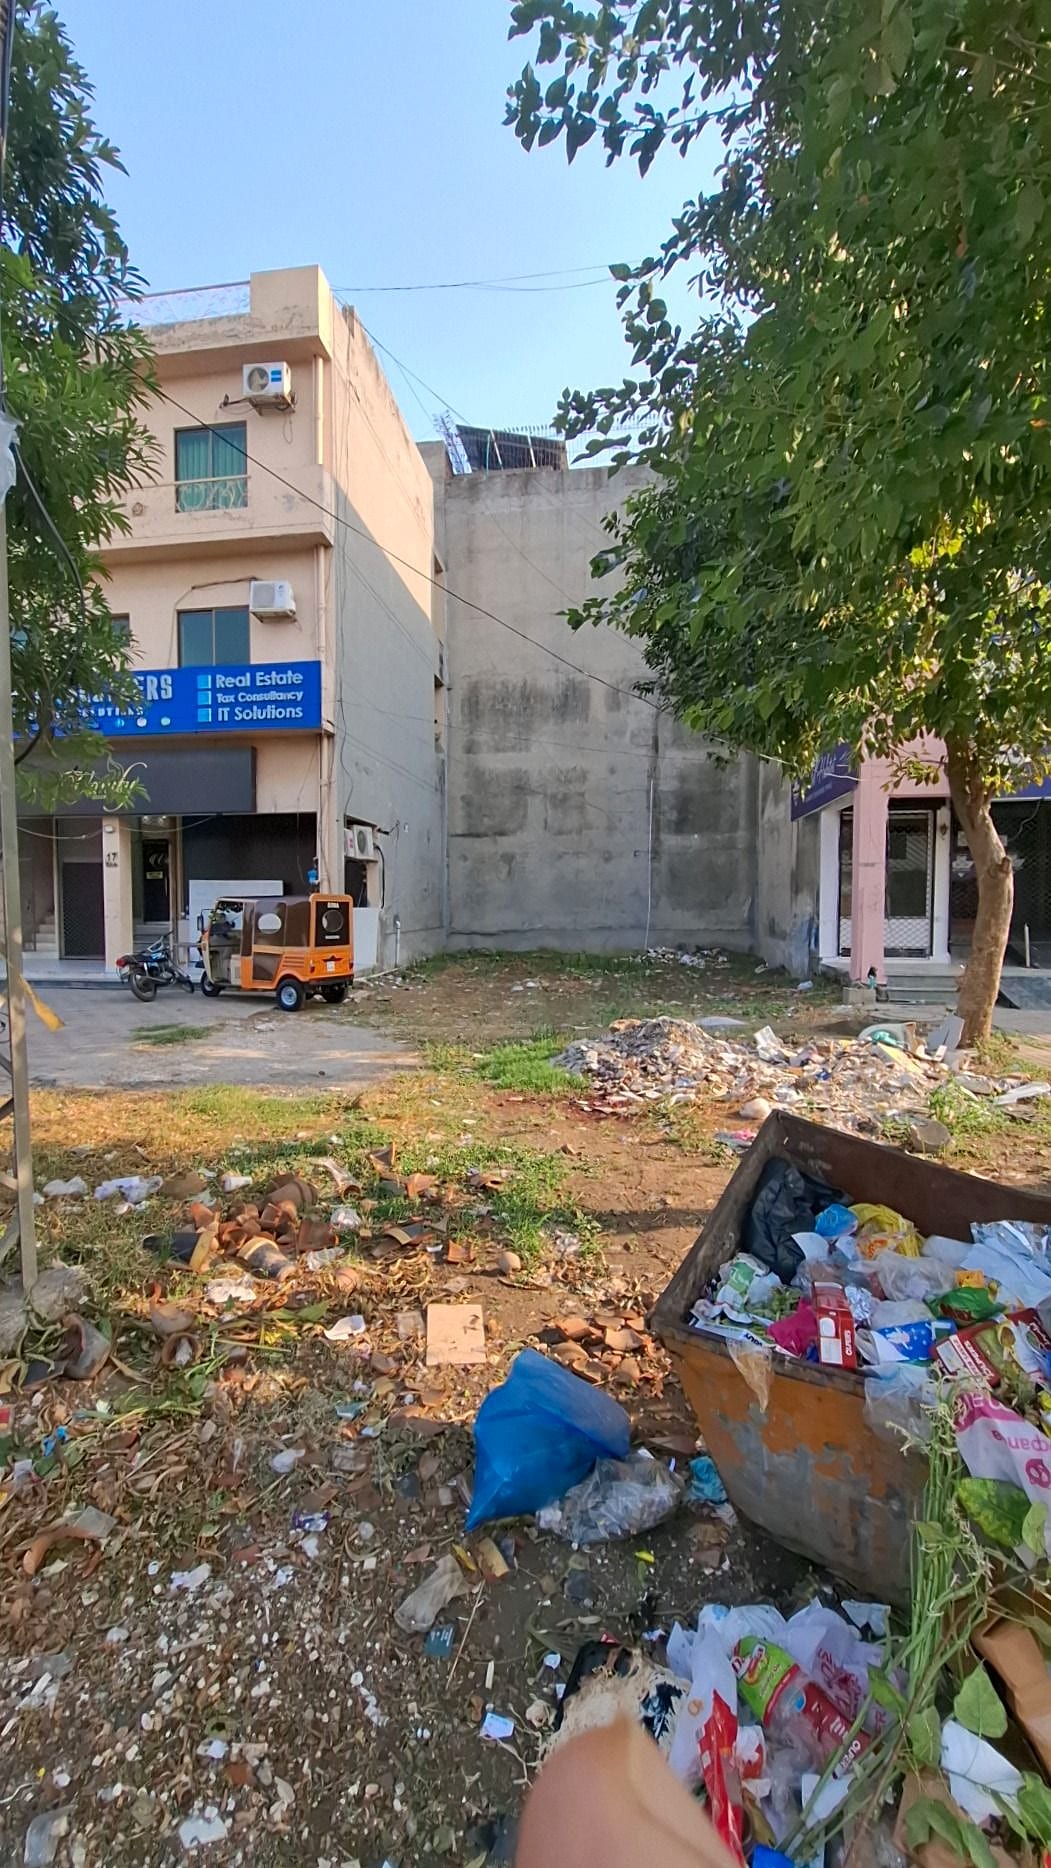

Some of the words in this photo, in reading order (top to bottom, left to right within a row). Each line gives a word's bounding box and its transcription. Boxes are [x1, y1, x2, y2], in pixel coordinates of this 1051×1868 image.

[215, 672, 251, 689] Real
[255, 670, 304, 687] Estate
[216, 693, 236, 704] Tax
[237, 690, 304, 703] Consultancy
[217, 707, 231, 722] IT
[234, 704, 303, 721] Solutions
